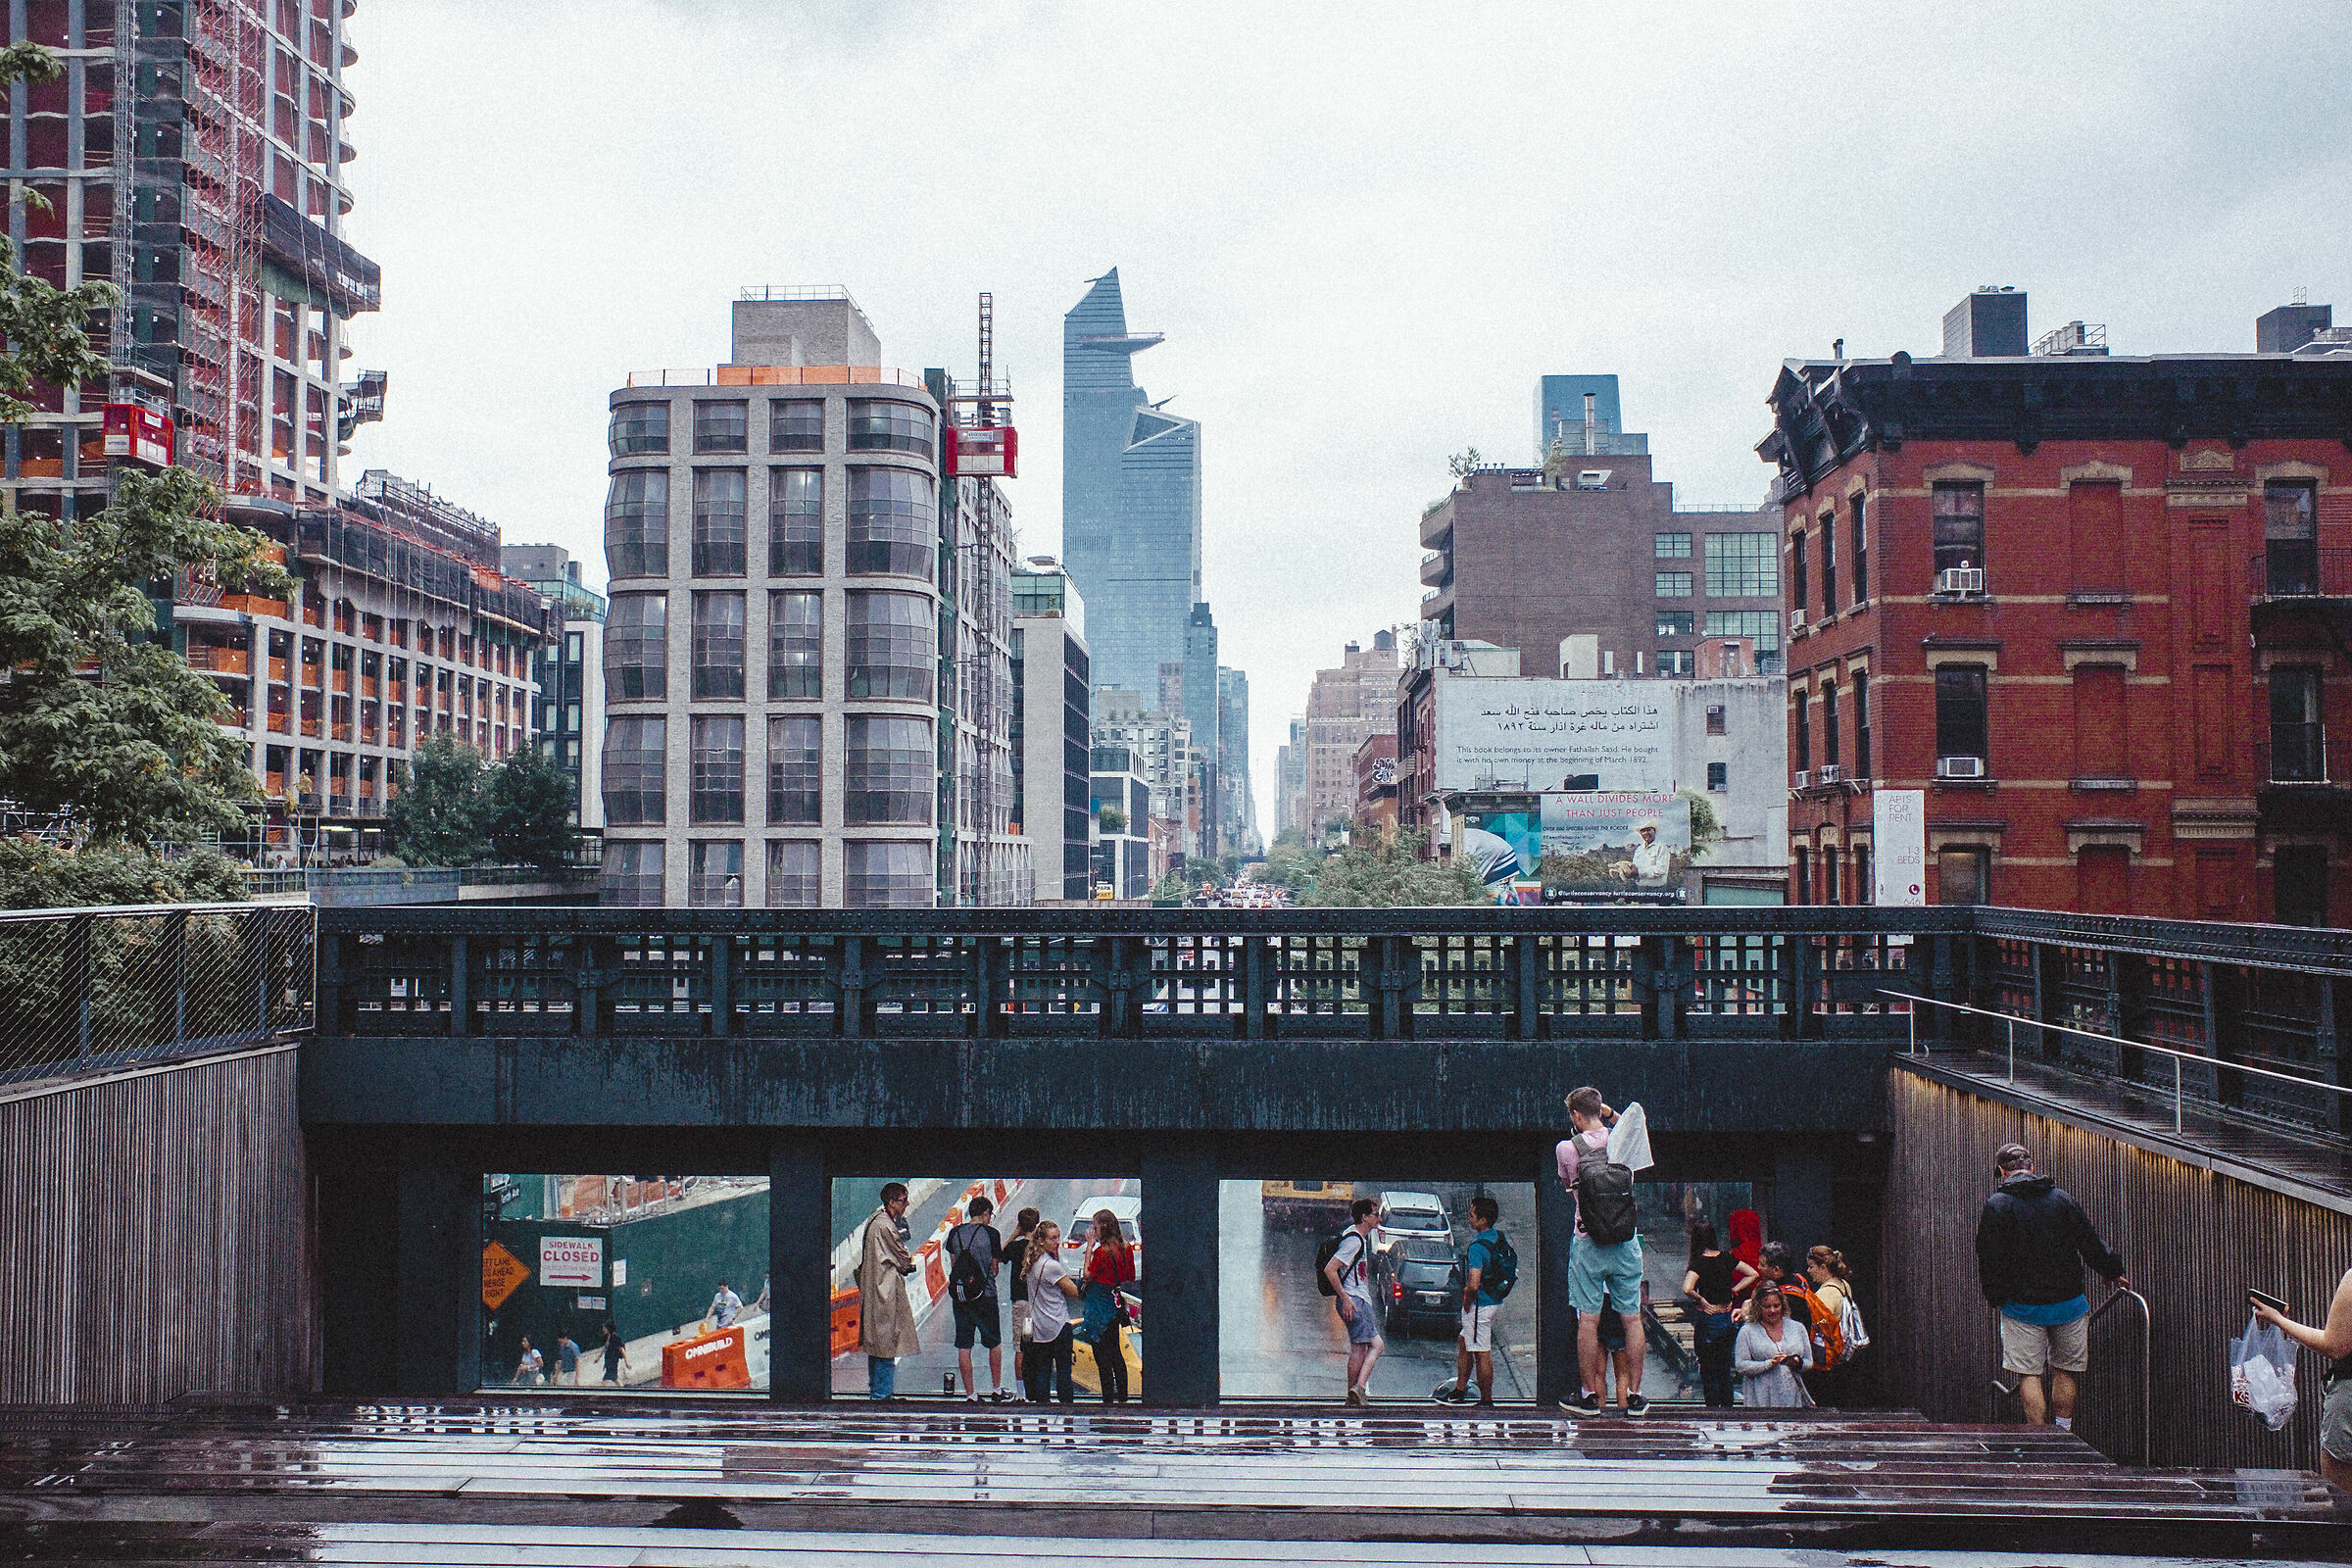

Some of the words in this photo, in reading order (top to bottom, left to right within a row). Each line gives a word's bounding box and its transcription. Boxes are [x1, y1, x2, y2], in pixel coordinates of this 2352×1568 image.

[1505, 704, 1520, 715] الله
[1524, 708, 1540, 719] فتح
[1544, 708, 1576, 717] صاحبه
[1611, 706, 1640, 718] الكتاب
[1643, 706, 1658, 715] هذا
[1497, 722, 1524, 731] ١٨٩٢
[1528, 721, 1546, 731] سنة
[1570, 722, 1587, 733] غرة
[1591, 721, 1607, 730] ماله
[1612, 723, 1626, 732] من
[1494, 746, 1522, 755] belongs
[1634, 746, 1659, 755] bought
[1555, 796, 1563, 805] A
[1566, 795, 1594, 805] WALL
[1597, 794, 1639, 804] DIVIDES
[1642, 794, 1674, 804] MORE
[1888, 795, 1912, 804] APTS
[1566, 808, 1594, 817] THAN
[1598, 808, 1623, 817] JUST
[1626, 808, 1664, 817] PEOPLE
[1888, 804, 1909, 812] FOR
[1888, 813, 1913, 822] RENT
[1897, 856, 1920, 864] BEDS
[1903, 898, 1921, 906] 646
[549, 1241, 594, 1250] SIDEWALK
[543, 1250, 600, 1263] CLOSED
[685, 1337, 733, 1360] OMNIBUILD
